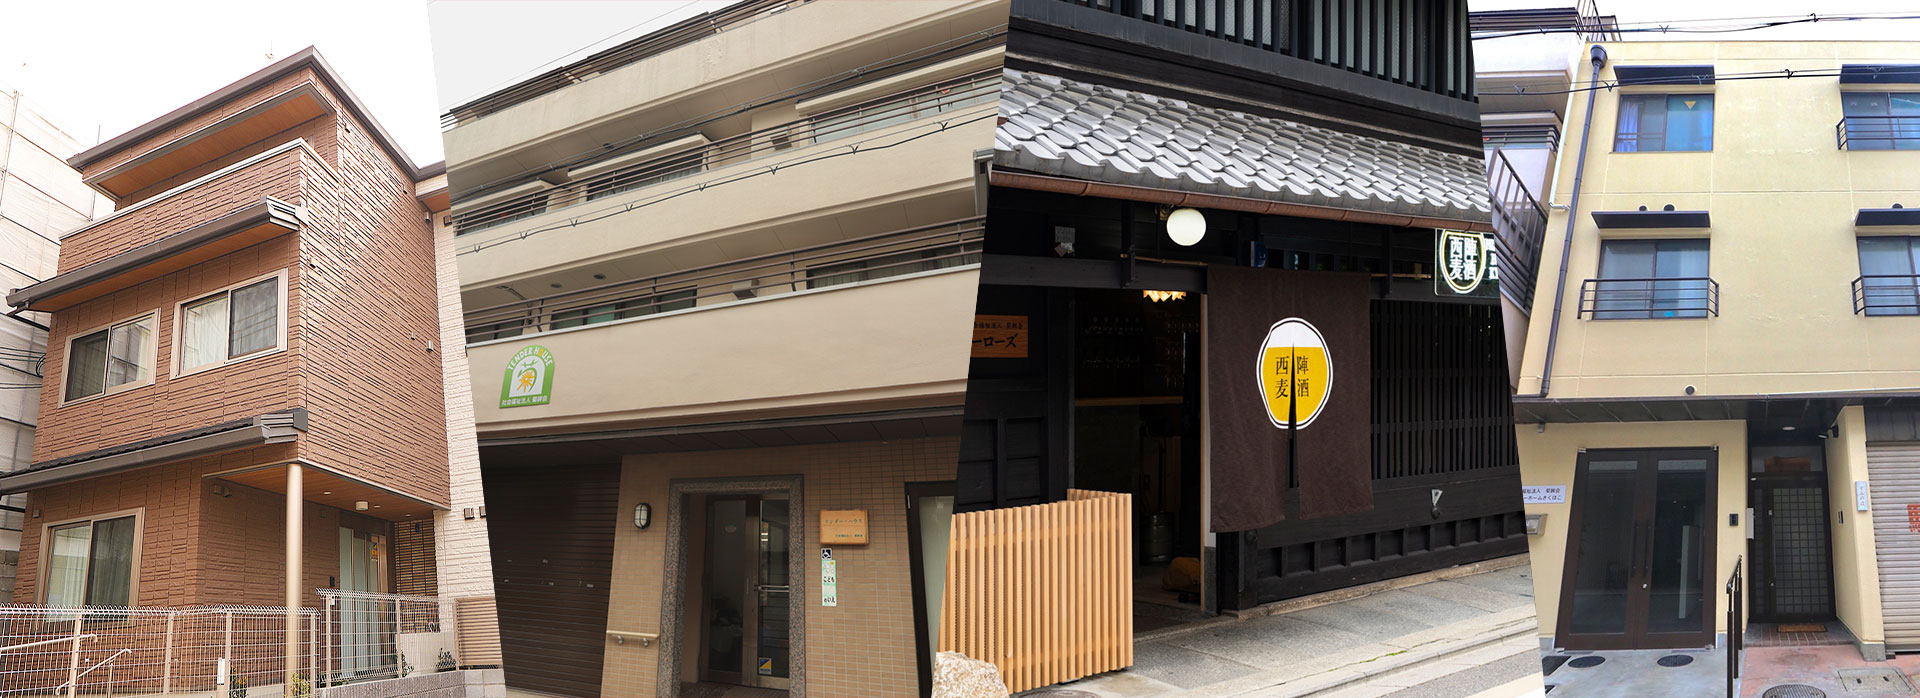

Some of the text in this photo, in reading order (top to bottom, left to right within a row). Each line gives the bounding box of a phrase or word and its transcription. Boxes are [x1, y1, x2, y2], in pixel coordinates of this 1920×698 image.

[1448, 236, 1478, 260] 西陣
[507, 346, 553, 370] TENDER HOUSE
[1275, 355, 1309, 375] 西陣
[1275, 378, 1309, 399] 麦酒
